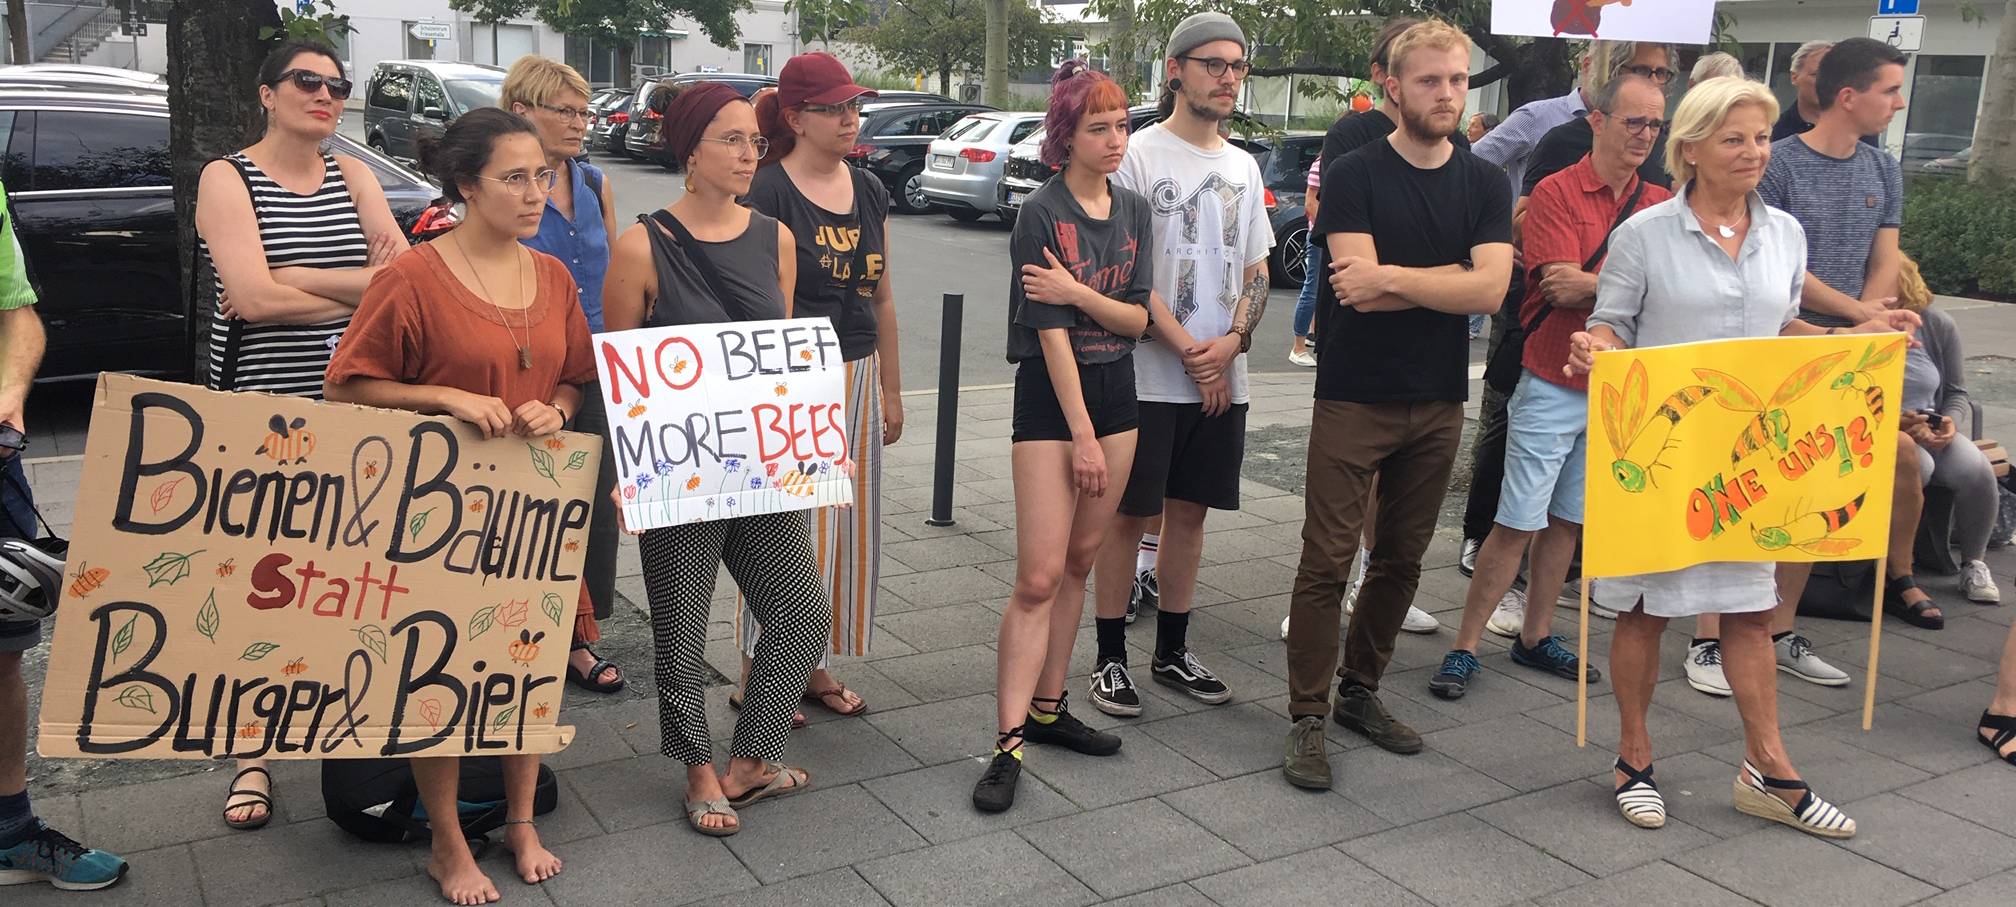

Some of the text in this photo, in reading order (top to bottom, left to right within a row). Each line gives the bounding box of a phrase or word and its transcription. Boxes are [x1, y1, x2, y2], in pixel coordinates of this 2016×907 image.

[602, 326, 837, 404] NO BEEF
[113, 392, 346, 548] Bienen
[385, 420, 590, 586] Bäume
[616, 403, 848, 478] MORE BEES
[77, 600, 346, 759] Burger
[381, 609, 558, 756] Bier
